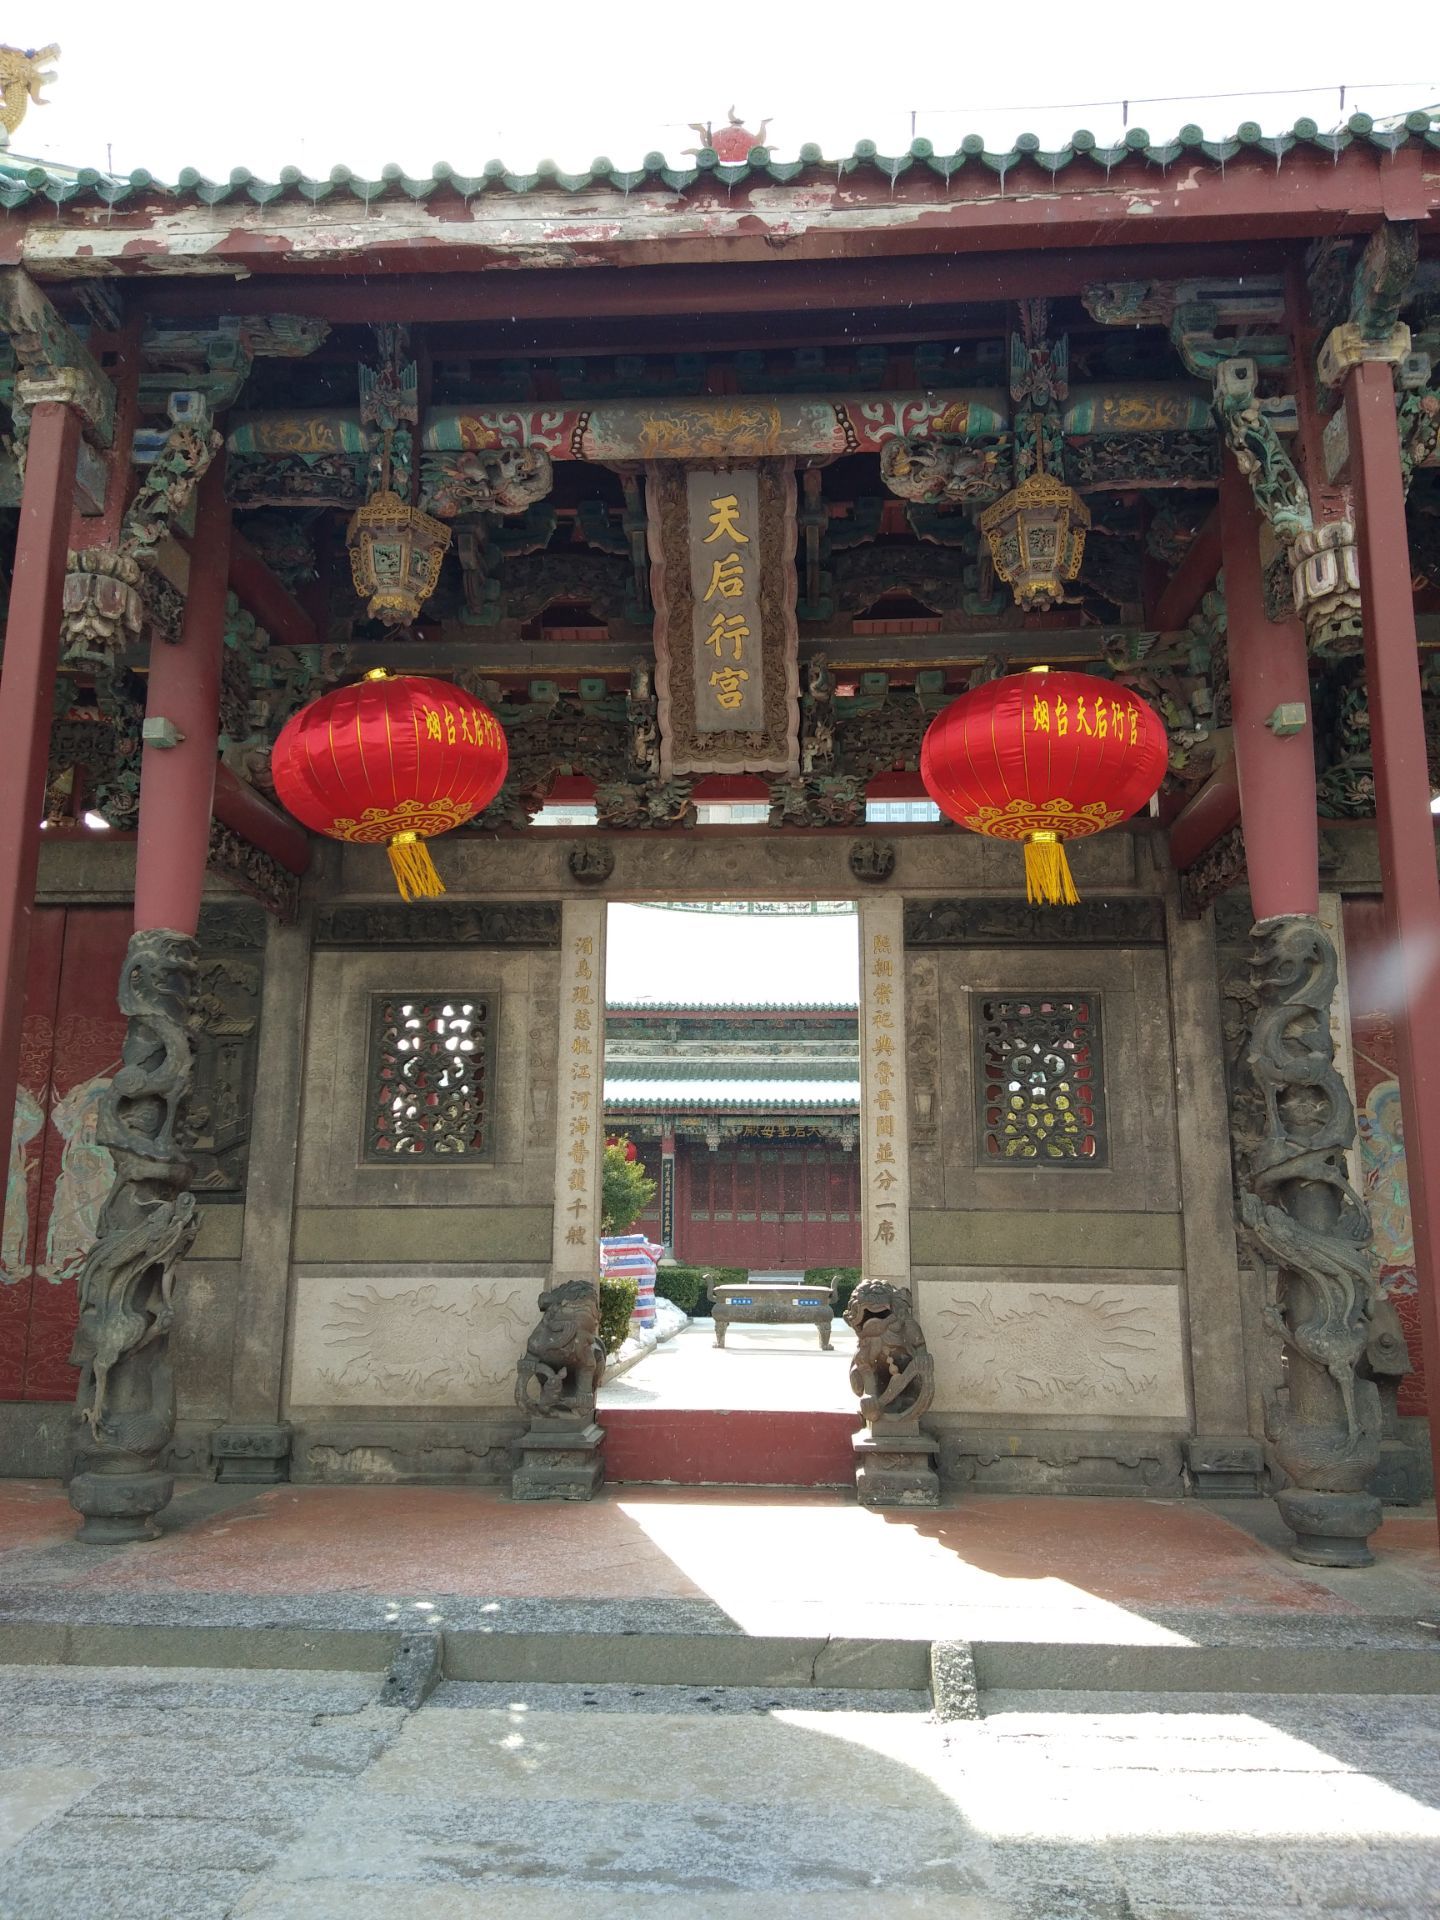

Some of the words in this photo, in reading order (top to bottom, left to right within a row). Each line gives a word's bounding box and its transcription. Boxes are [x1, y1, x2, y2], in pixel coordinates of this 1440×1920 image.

[1032, 694, 1139, 746] 烟台天后行宫
